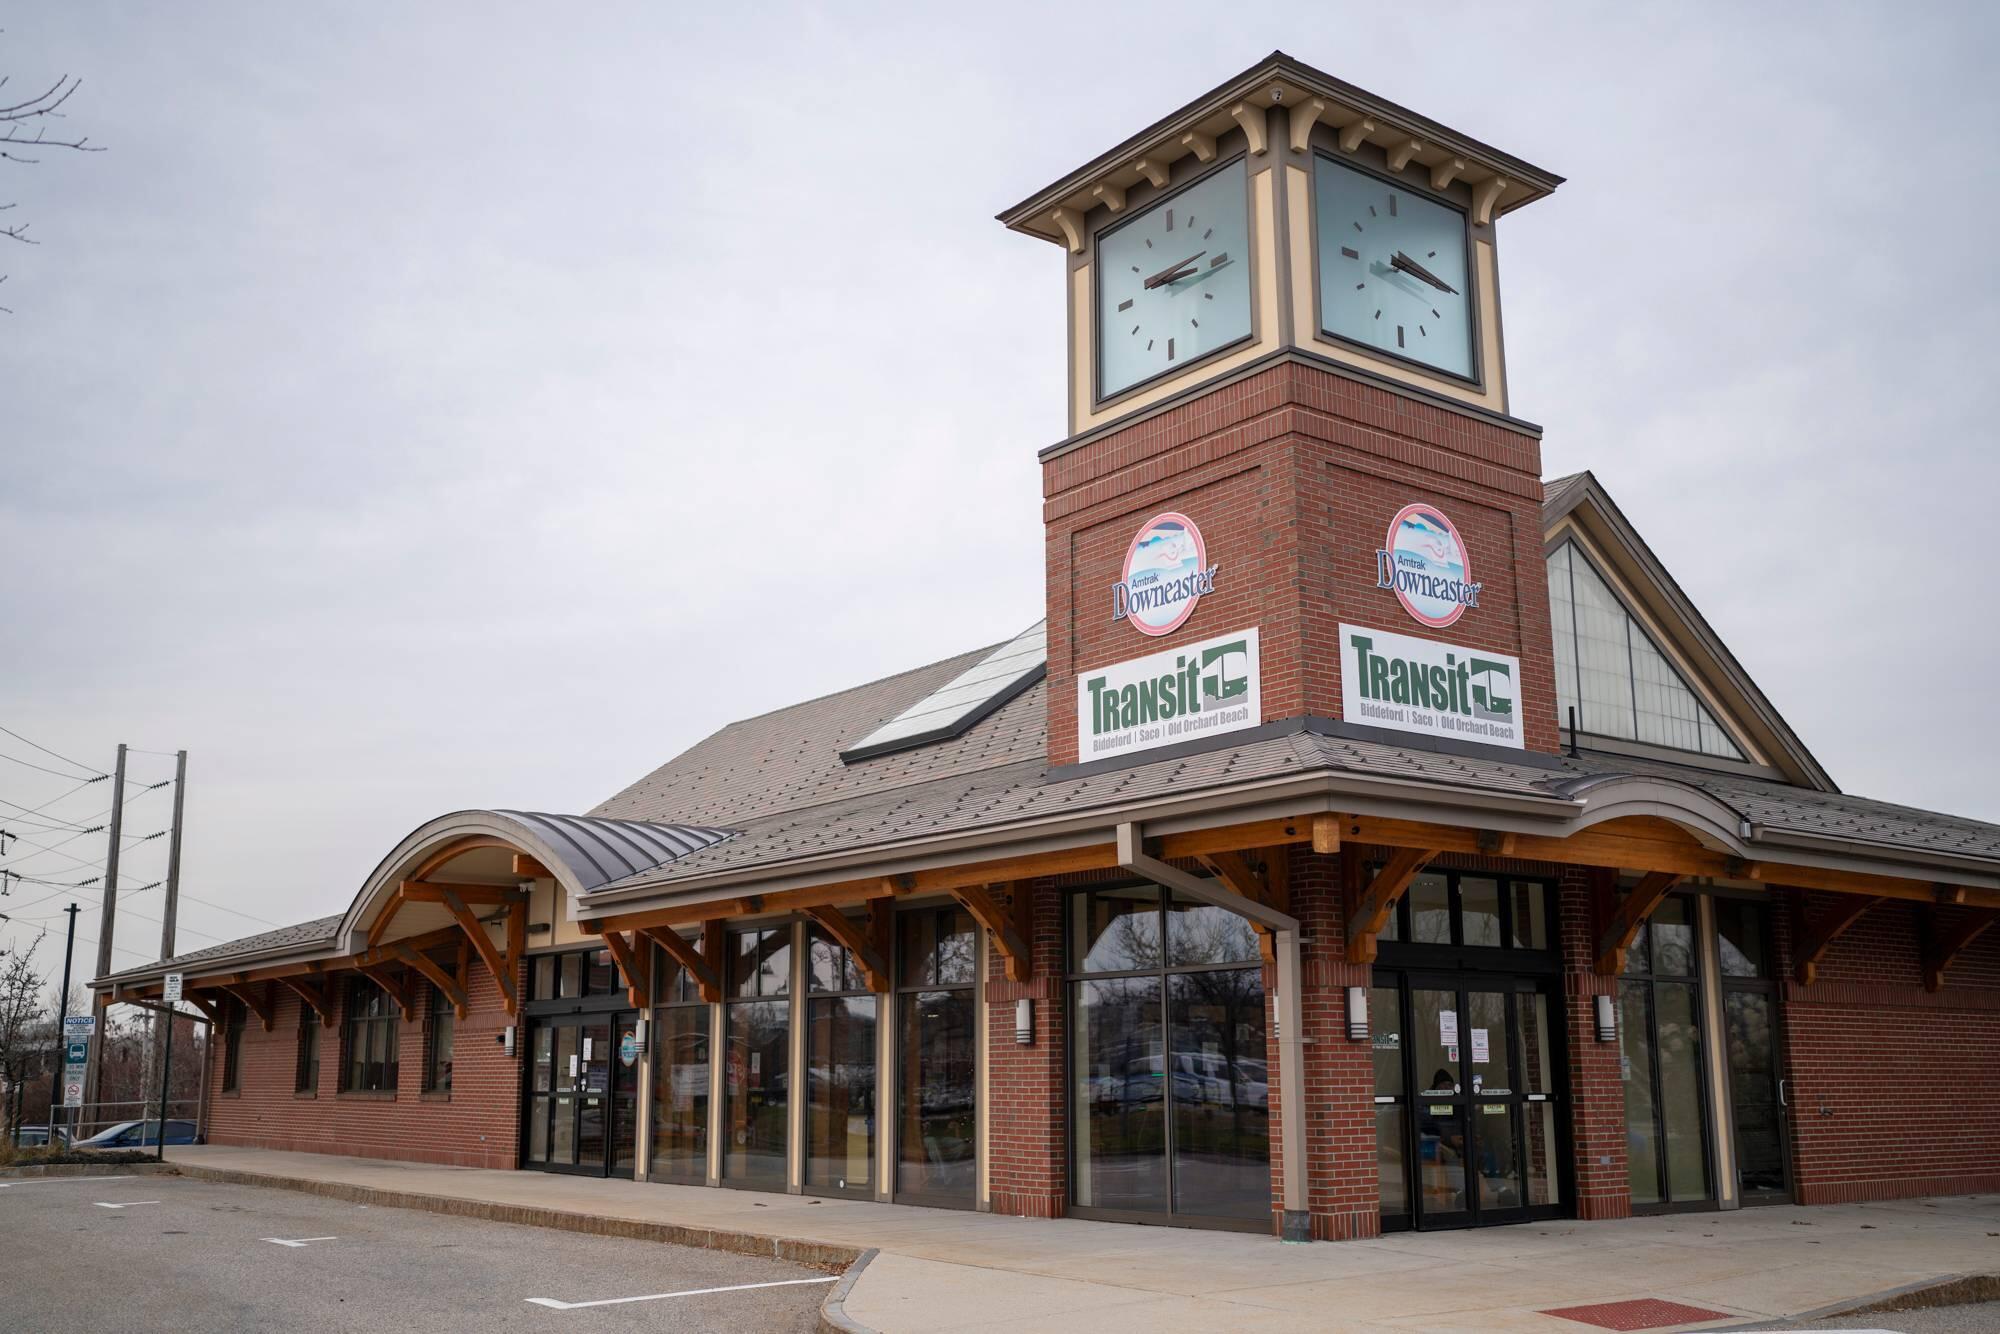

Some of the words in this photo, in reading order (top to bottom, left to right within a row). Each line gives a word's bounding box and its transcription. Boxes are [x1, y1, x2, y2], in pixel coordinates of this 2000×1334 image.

[1131, 573, 1159, 589] Amtrak
[1377, 551, 1479, 607] Downeaster
[1398, 554, 1426, 570] Amtrak
[1113, 568, 1215, 619] Downeaster
[1093, 732, 1131, 752] Biddeford
[1140, 727, 1160, 742] Saco
[1168, 720, 1182, 736] Old
[1184, 714, 1218, 733] Orchard
[1220, 707, 1248, 724] Beach
[1360, 703, 1403, 722] Biddeford
[1412, 711, 1433, 727] Saco
[1441, 715, 1455, 730] Old
[1456, 719, 1488, 735] Orchard
[1490, 723, 1514, 739] Beach
